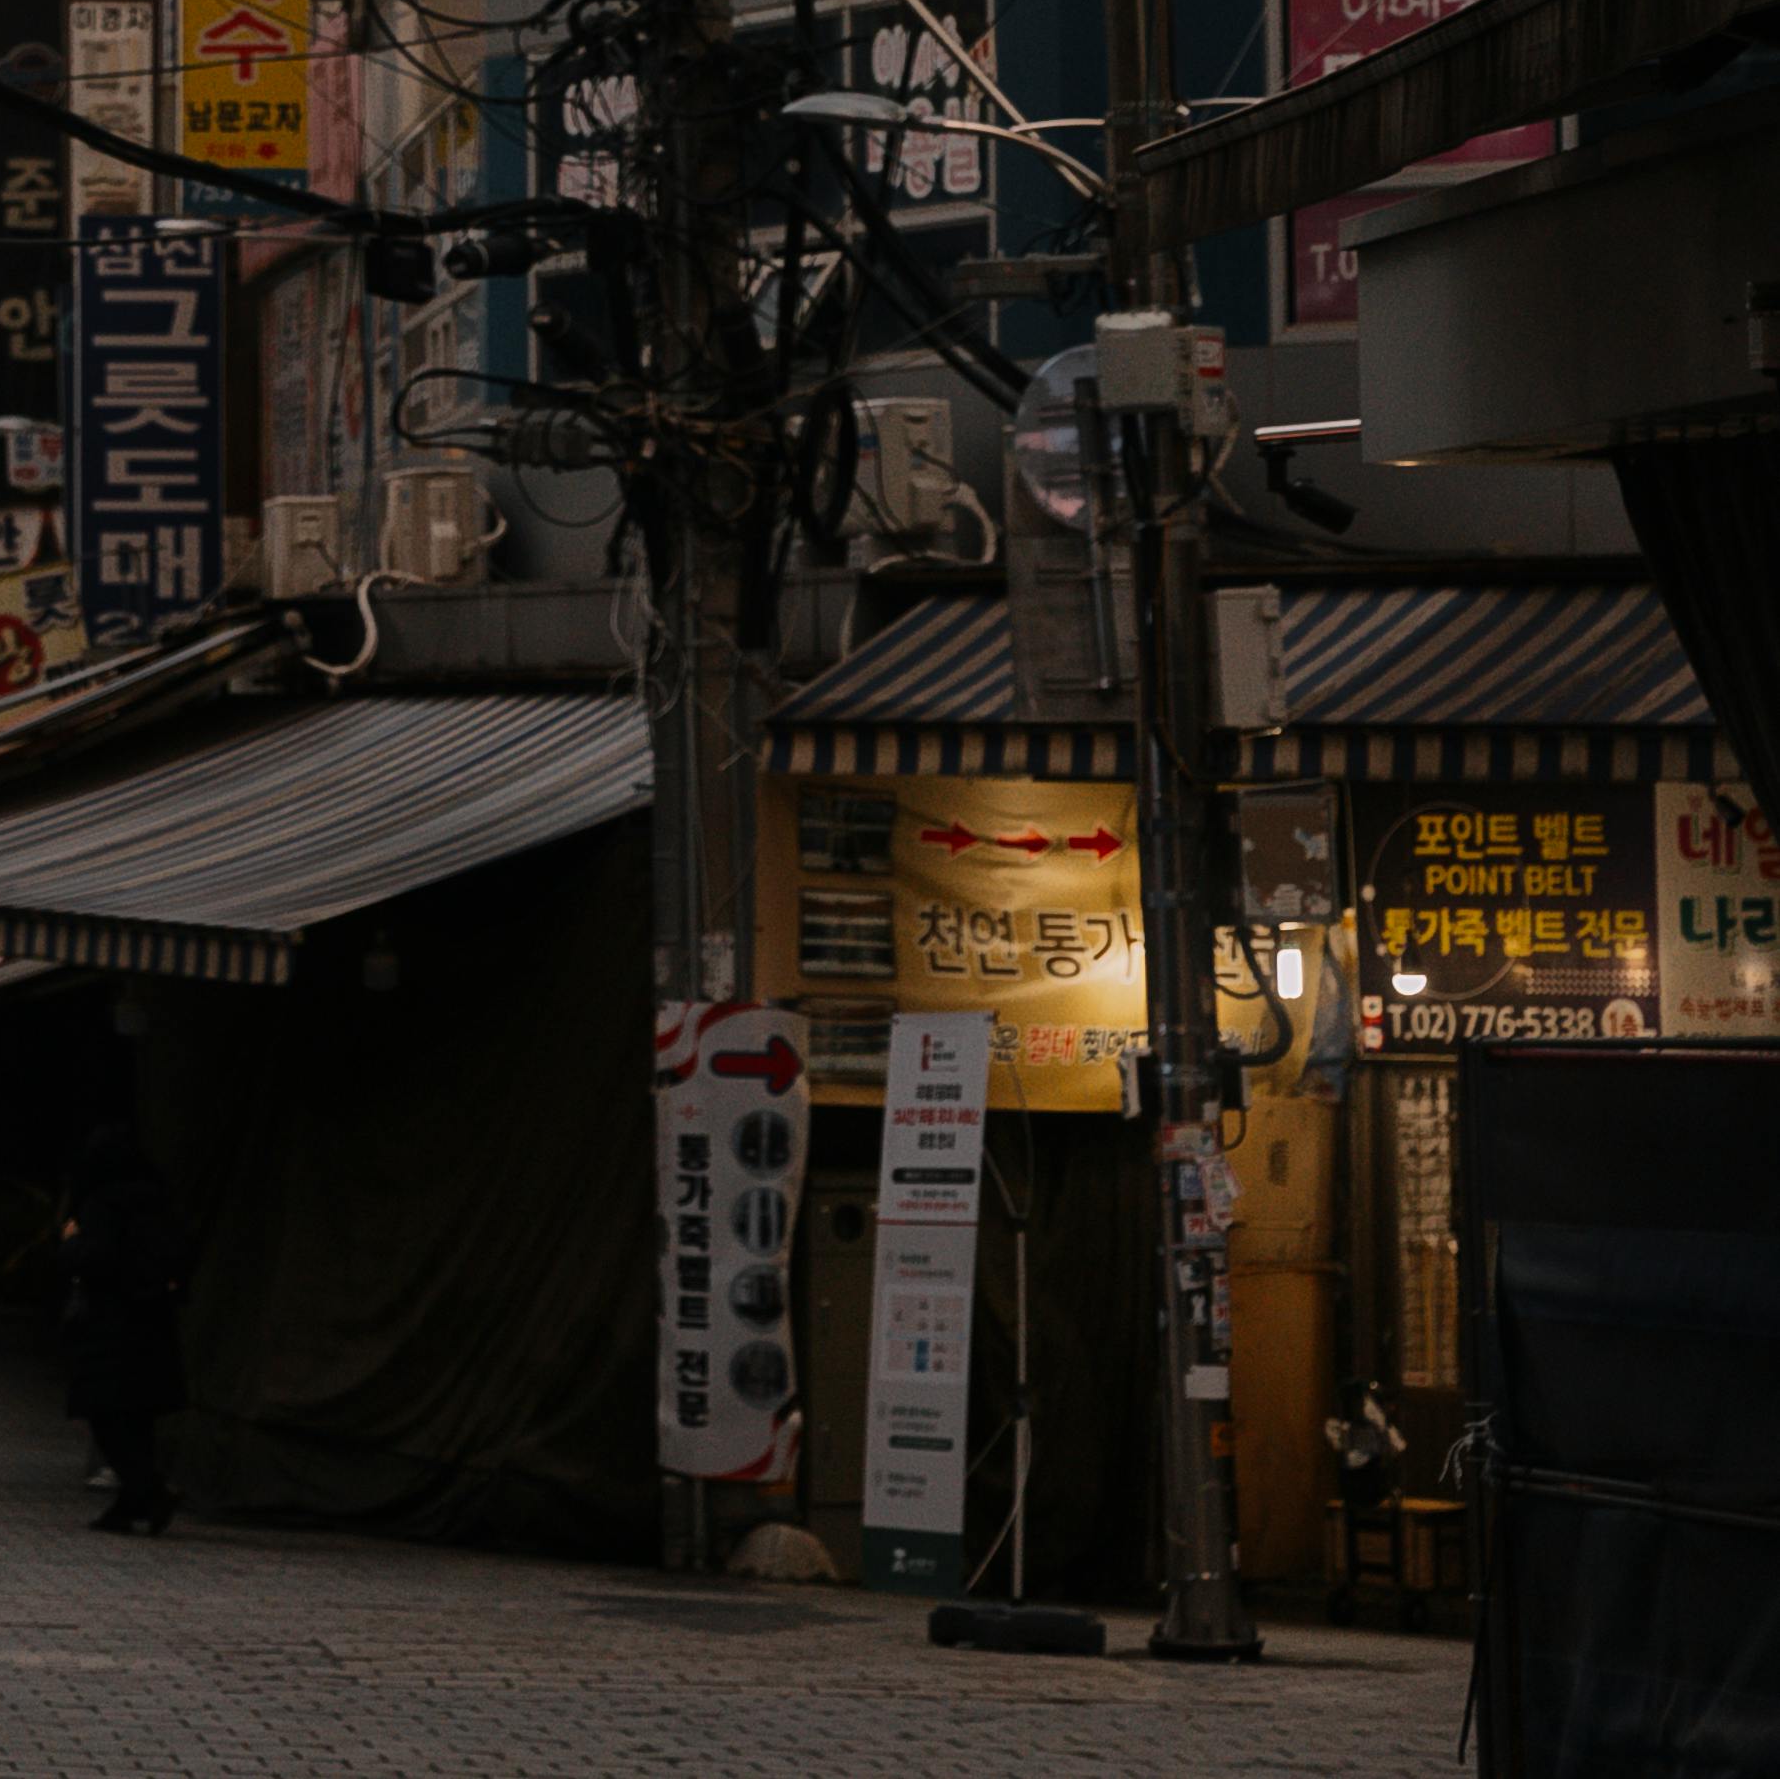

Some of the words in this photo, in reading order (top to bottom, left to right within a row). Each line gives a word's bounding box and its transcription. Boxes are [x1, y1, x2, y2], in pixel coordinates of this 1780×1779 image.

[91, 289, 210, 602] 그릇도매
[1413, 812, 1524, 861] 포인트
[1531, 812, 1609, 862] 벨트
[1424, 864, 1518, 897] POINT
[1523, 864, 1598, 897] BELT
[918, 906, 1018, 979] 천연
[1496, 908, 1571, 958] 벨트
[1576, 909, 1649, 959] 전문
[1462, 1004, 1596, 1042] 776-5338
[676, 1134, 711, 1330] 통가죽벨트
[676, 1349, 711, 1428] 전문
